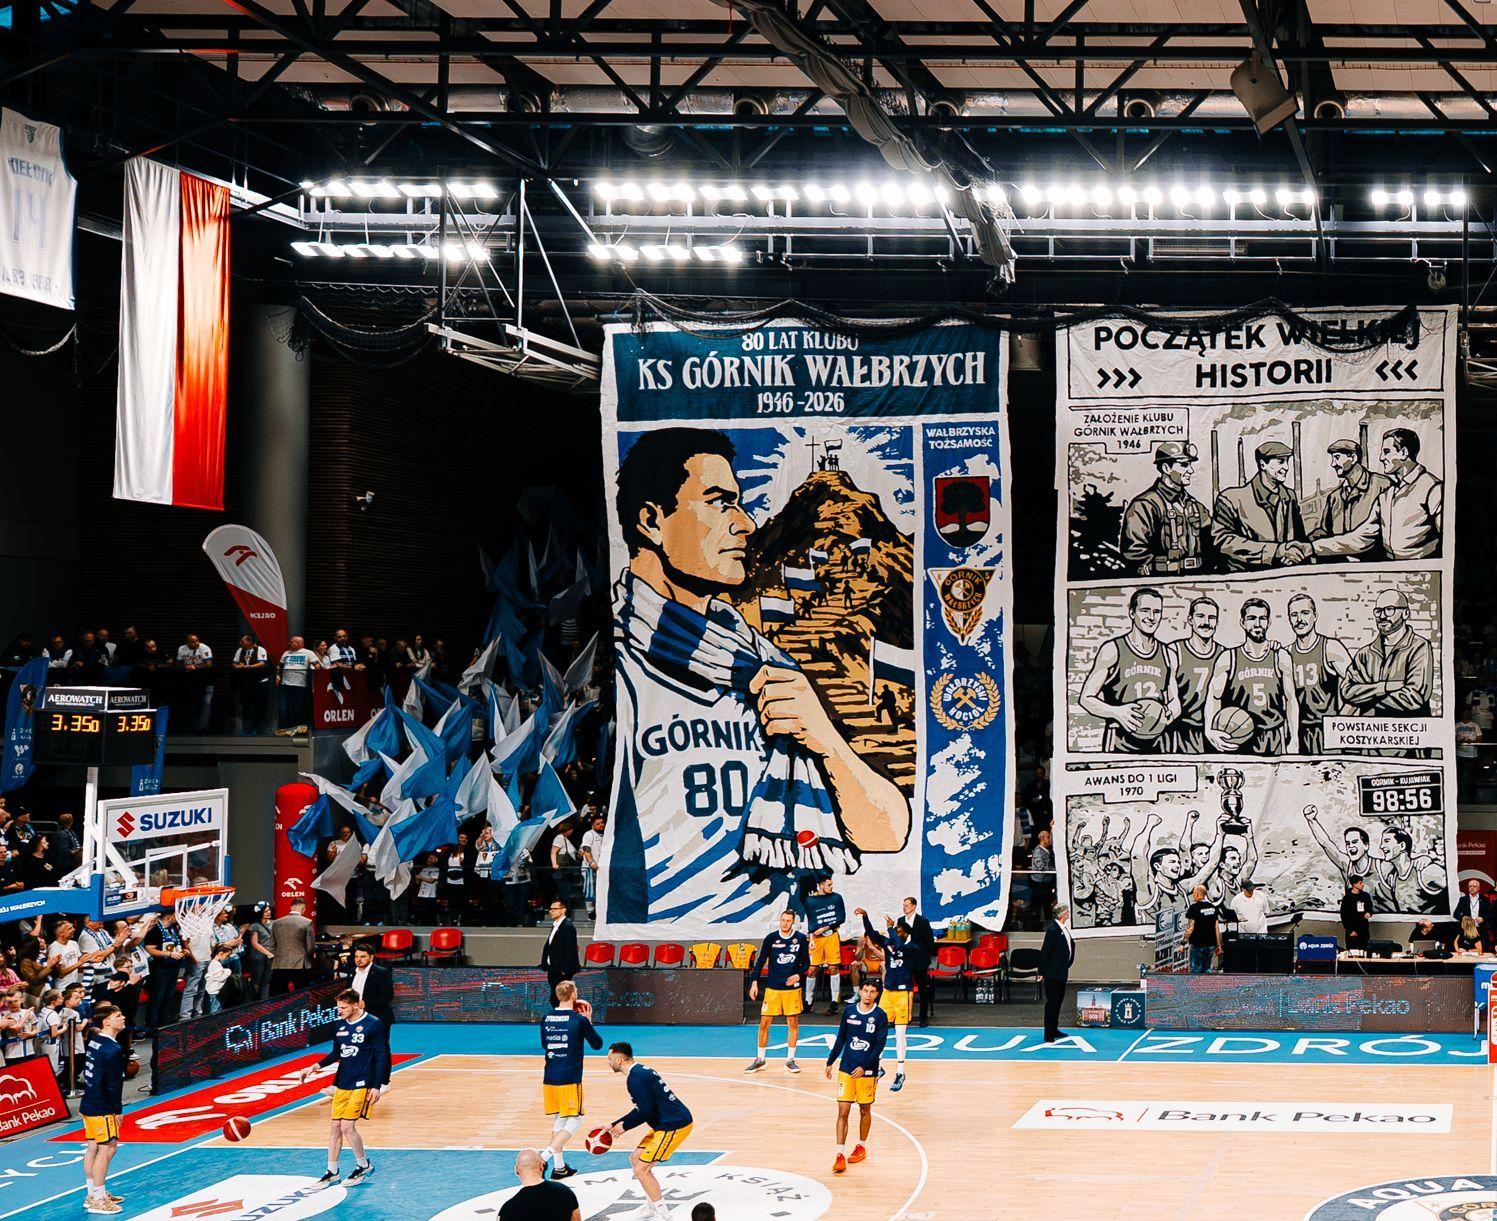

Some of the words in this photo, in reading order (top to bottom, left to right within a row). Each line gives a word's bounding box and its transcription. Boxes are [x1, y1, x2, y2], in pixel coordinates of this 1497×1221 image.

[742, 332, 764, 351] 80
[768, 331, 798, 349] LAT
[1094, 324, 1266, 358] POCZĄTEK
[638, 358, 673, 390] KS
[682, 351, 796, 388] GÓRNIK
[803, 351, 986, 389] WAŁBRZYCH
[1195, 358, 1333, 389] HISTORII
[1083, 411, 1140, 424] ZAŁOŻENIE
[1142, 413, 1174, 423] KLUBU
[926, 427, 996, 439] WAŁBRZYSKA
[1074, 424, 1117, 437] GÓRNIK
[1120, 425, 1184, 436] WAŁBRZYCH
[928, 438, 993, 450] TOŻSAMOŚĆ
[1117, 440, 1141, 449] 1946
[1124, 661, 1162, 678] GÓRNIK
[1238, 666, 1276, 681] GÓRNIK
[1295, 662, 1319, 687] 13
[1194, 667, 1209, 692] 7
[1134, 681, 1159, 699] 12
[1252, 684, 1267, 707] 5
[48, 694, 103, 704] AEROWATCH
[110, 695, 147, 704] AEROWATCH
[324, 709, 355, 723] ORLEN
[641, 714, 762, 757] GÓRNIK
[1331, 722, 1389, 734] POWSTANIE
[1391, 721, 1428, 734] SEKCJI
[1339, 733, 1421, 747] KOSZYKARSKIEJ
[1085, 775, 1125, 787] AWANS
[1128, 774, 1146, 784] DO
[1157, 773, 1178, 784] LIGI
[682, 760, 749, 818] 80
[1119, 786, 1144, 797] 1970
[1372, 788, 1432, 812] 98:56
[139, 806, 212, 832] SUZUKI
[281, 890, 305, 898] ORLEN
[789, 944, 800, 953] 37
[261, 1012, 298, 1042] Bank
[865, 1022, 876, 1034] 10
[351, 1033, 365, 1044] 33
[1132, 1035, 1488, 1058] ZDRÓJ
[22, 1105, 56, 1127] Pekao
[1158, 1109, 1279, 1124] Bank
[1292, 1110, 1437, 1125] Pekao
[1347, 1177, 1485, 1211] AQUA
